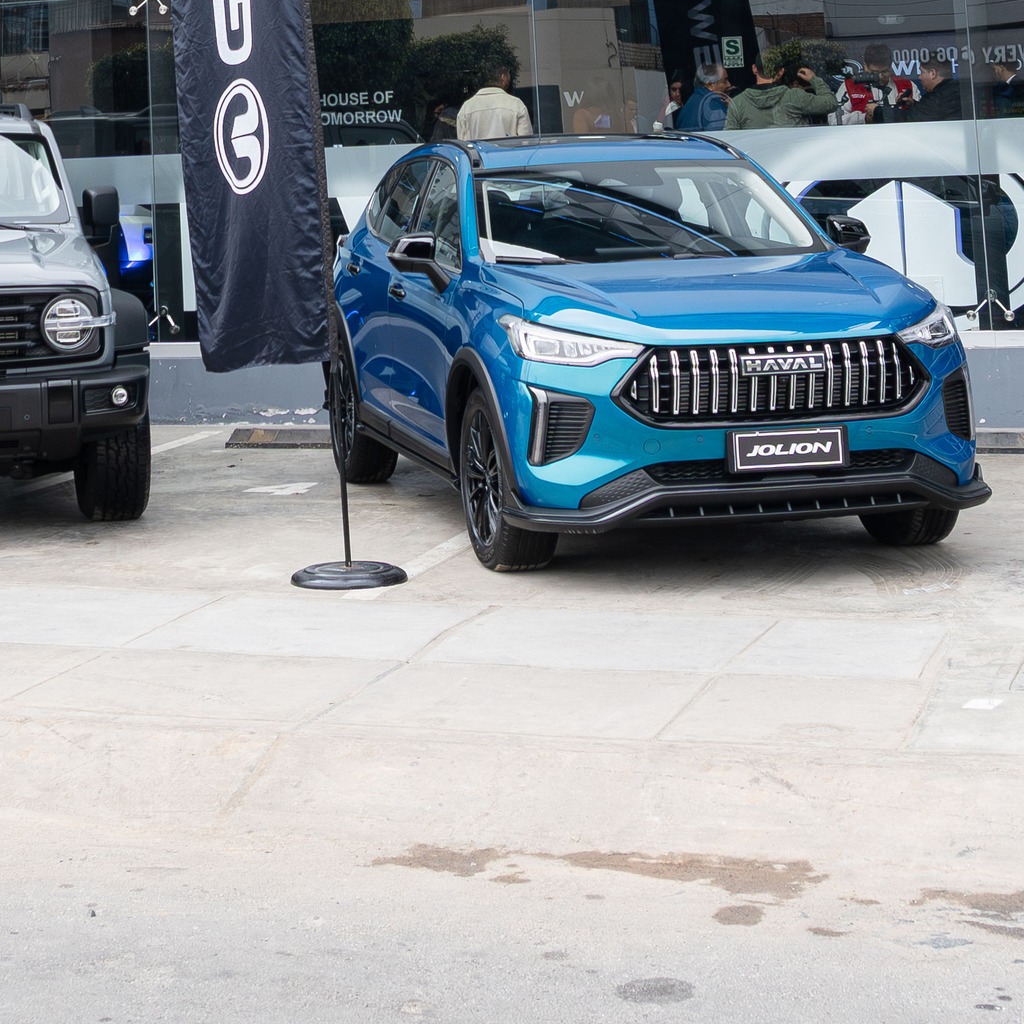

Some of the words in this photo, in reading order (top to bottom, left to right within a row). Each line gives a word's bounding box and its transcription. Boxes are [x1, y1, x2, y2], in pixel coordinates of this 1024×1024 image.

[726, 39, 739, 55] S
[373, 90, 394, 104] OF
[321, 109, 402, 126] OMORROW
[746, 356, 823, 372] HAVAL
[746, 441, 833, 458] JOLION
